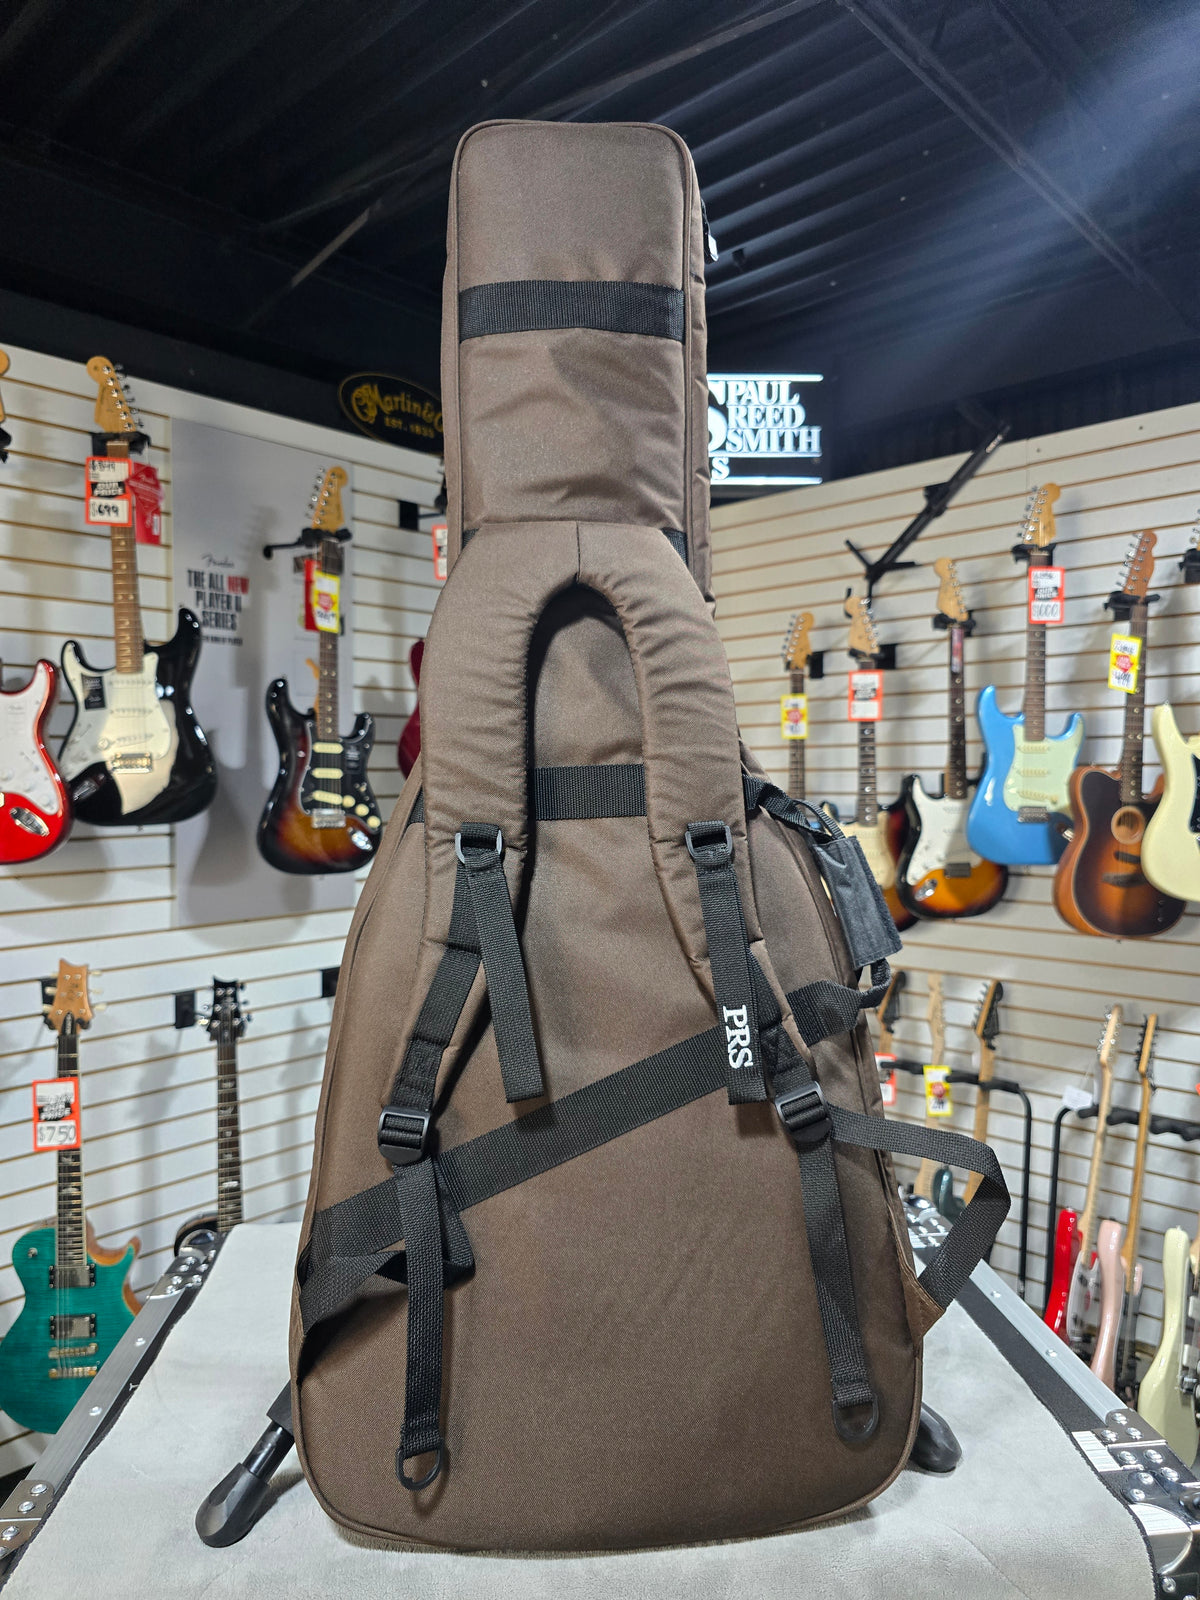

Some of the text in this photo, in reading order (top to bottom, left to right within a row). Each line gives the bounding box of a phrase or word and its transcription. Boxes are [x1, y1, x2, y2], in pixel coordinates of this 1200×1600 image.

[726, 380, 800, 405] PAUL
[727, 405, 806, 429] REED
[725, 426, 822, 453] SMITH
[187, 569, 205, 590] THE
[208, 573, 224, 593] ALL
[196, 591, 232, 611] PLAYER
[202, 610, 237, 631] SERIES
[723, 1004, 754, 1069] PRS
